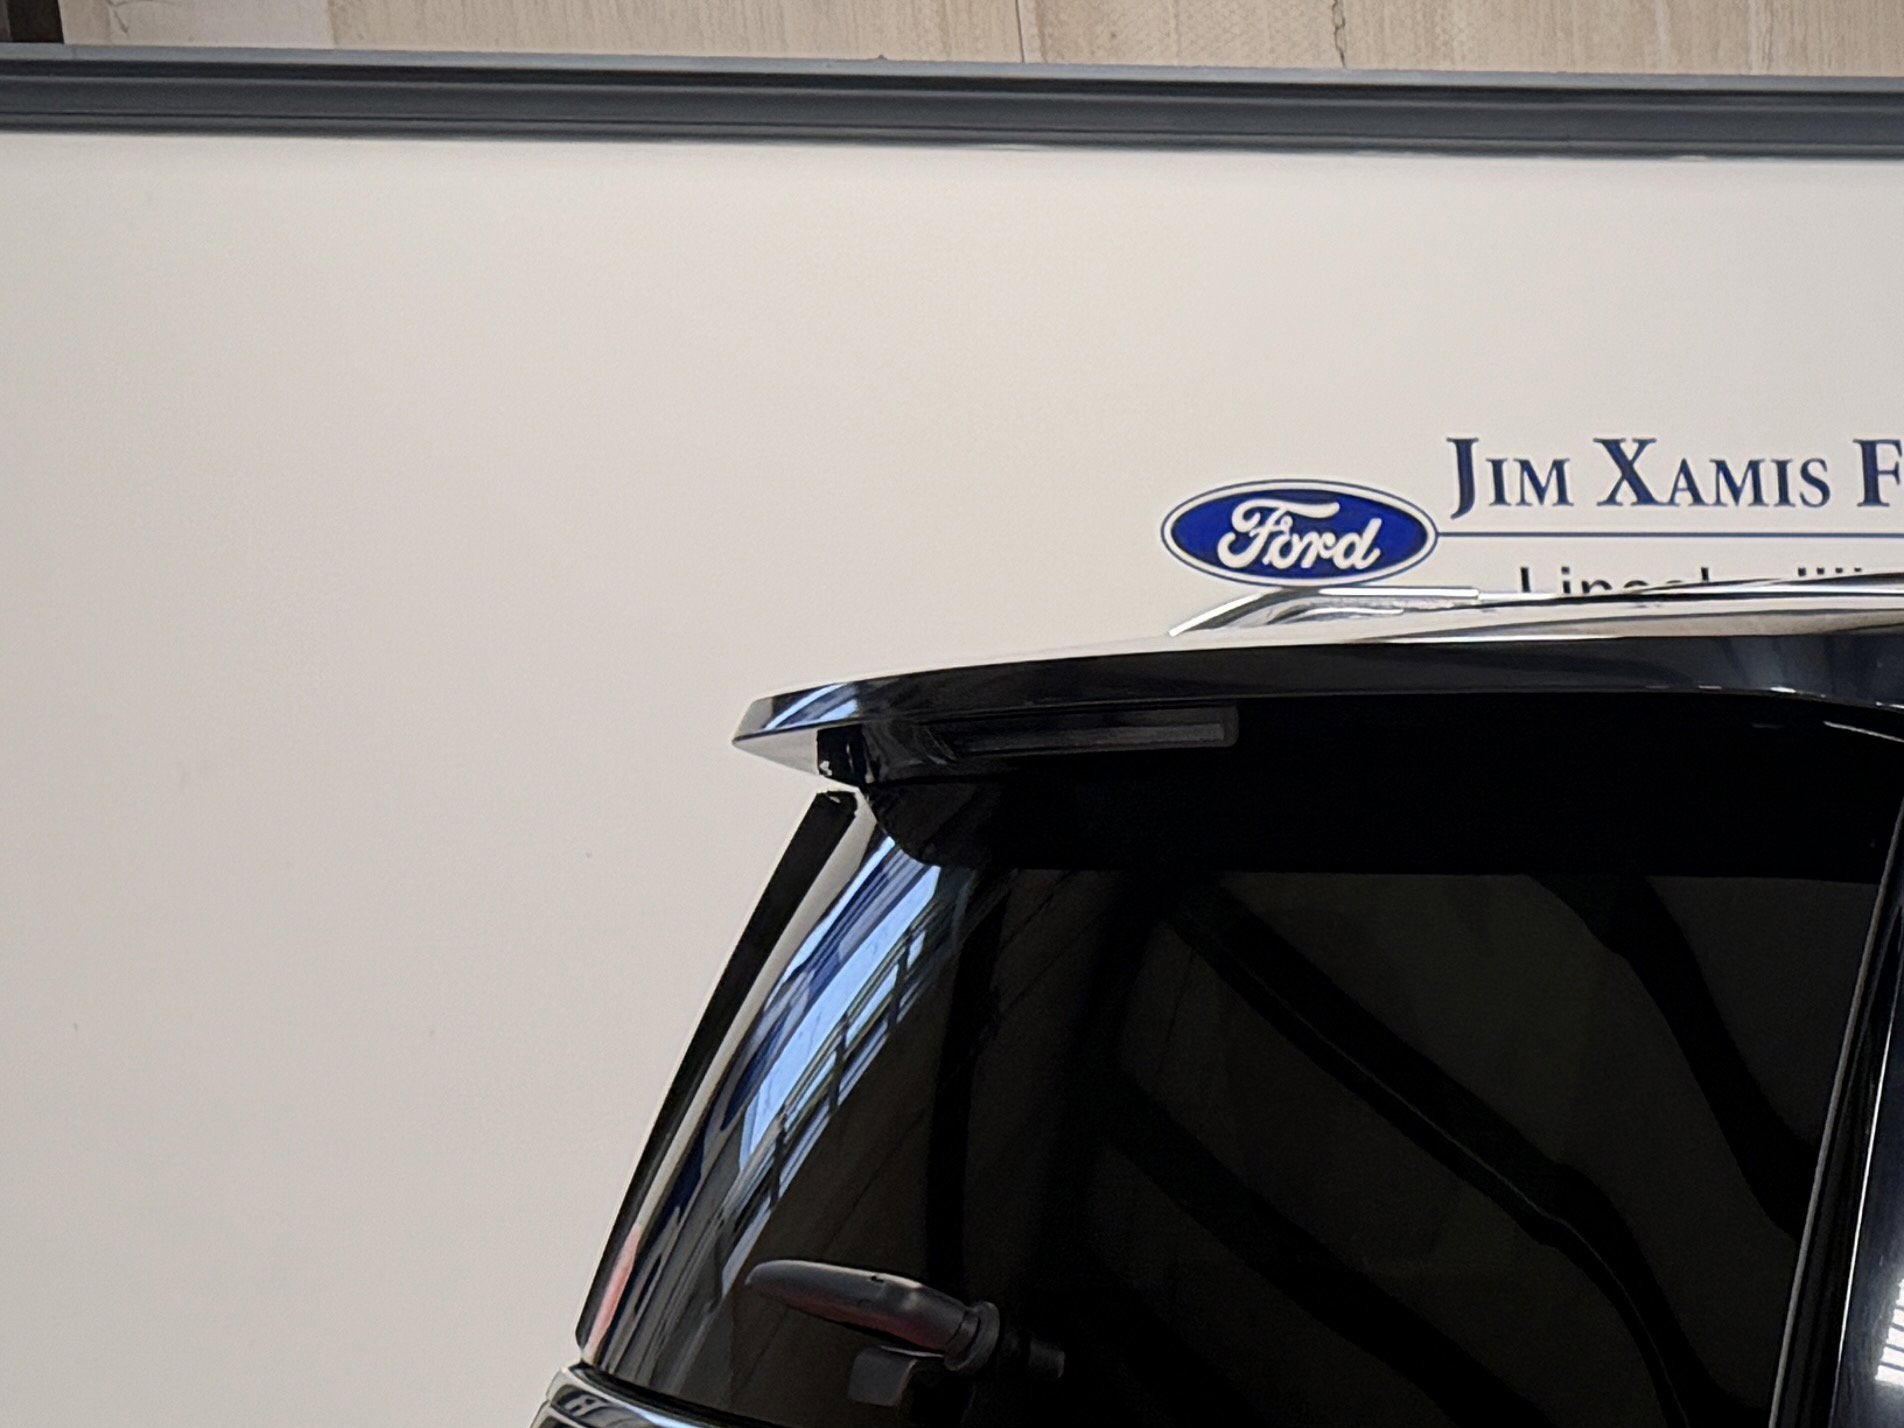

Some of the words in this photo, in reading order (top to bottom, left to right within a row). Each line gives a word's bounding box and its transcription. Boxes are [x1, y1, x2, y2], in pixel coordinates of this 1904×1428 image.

[1446, 437, 1574, 520] JIM
[1592, 437, 1831, 508] XAMIS
[1217, 498, 1383, 570] Ford
